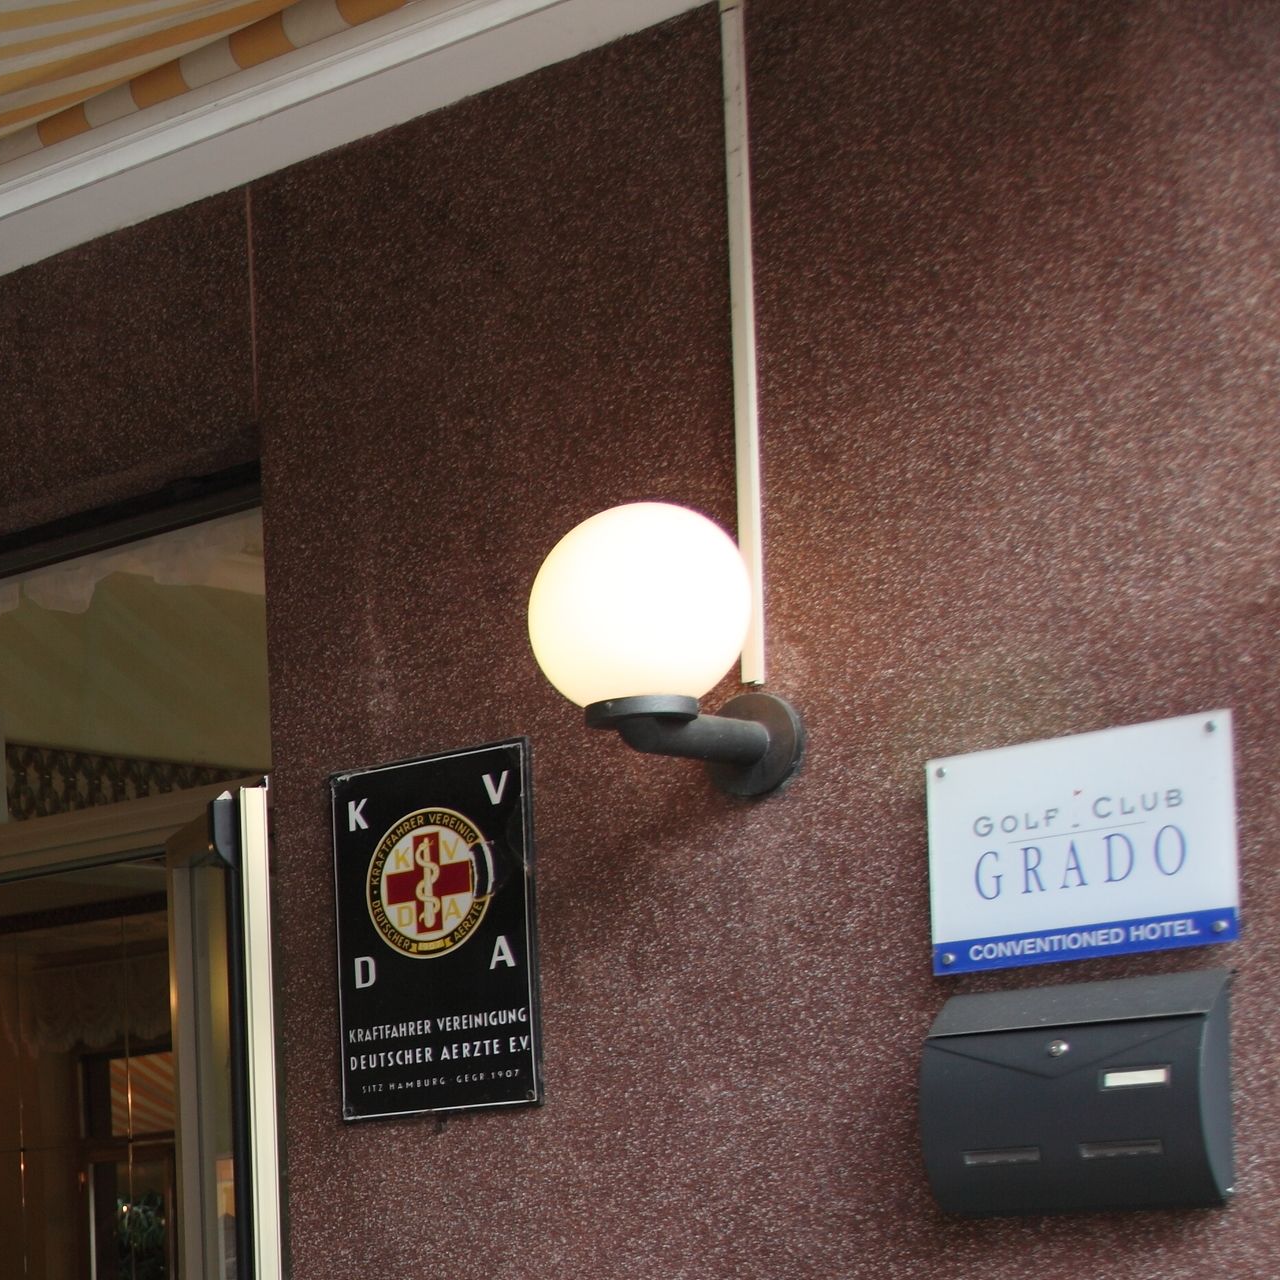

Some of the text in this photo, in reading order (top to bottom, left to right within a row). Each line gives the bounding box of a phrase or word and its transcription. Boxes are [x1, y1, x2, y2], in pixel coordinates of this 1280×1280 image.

[347, 770, 509, 832] K V
[972, 788, 1184, 838] GOLF CLUB
[371, 814, 425, 886] KRAFTFAHRER
[974, 824, 1187, 901] GRADO
[371, 900, 483, 950] DEUTSCHER AERZTE
[969, 918, 1200, 961] CONVENTIONED HOTEL
[354, 935, 516, 989] D A
[349, 1007, 527, 1043] KRAFTFAHRER VEREINIGUNG
[350, 1035, 531, 1071] DEUTSCHER AERZTE E.V.
[362, 1082, 383, 1094] SITZ
[389, 1076, 446, 1091] HAMBURG
[491, 1068, 521, 1079] 1907
